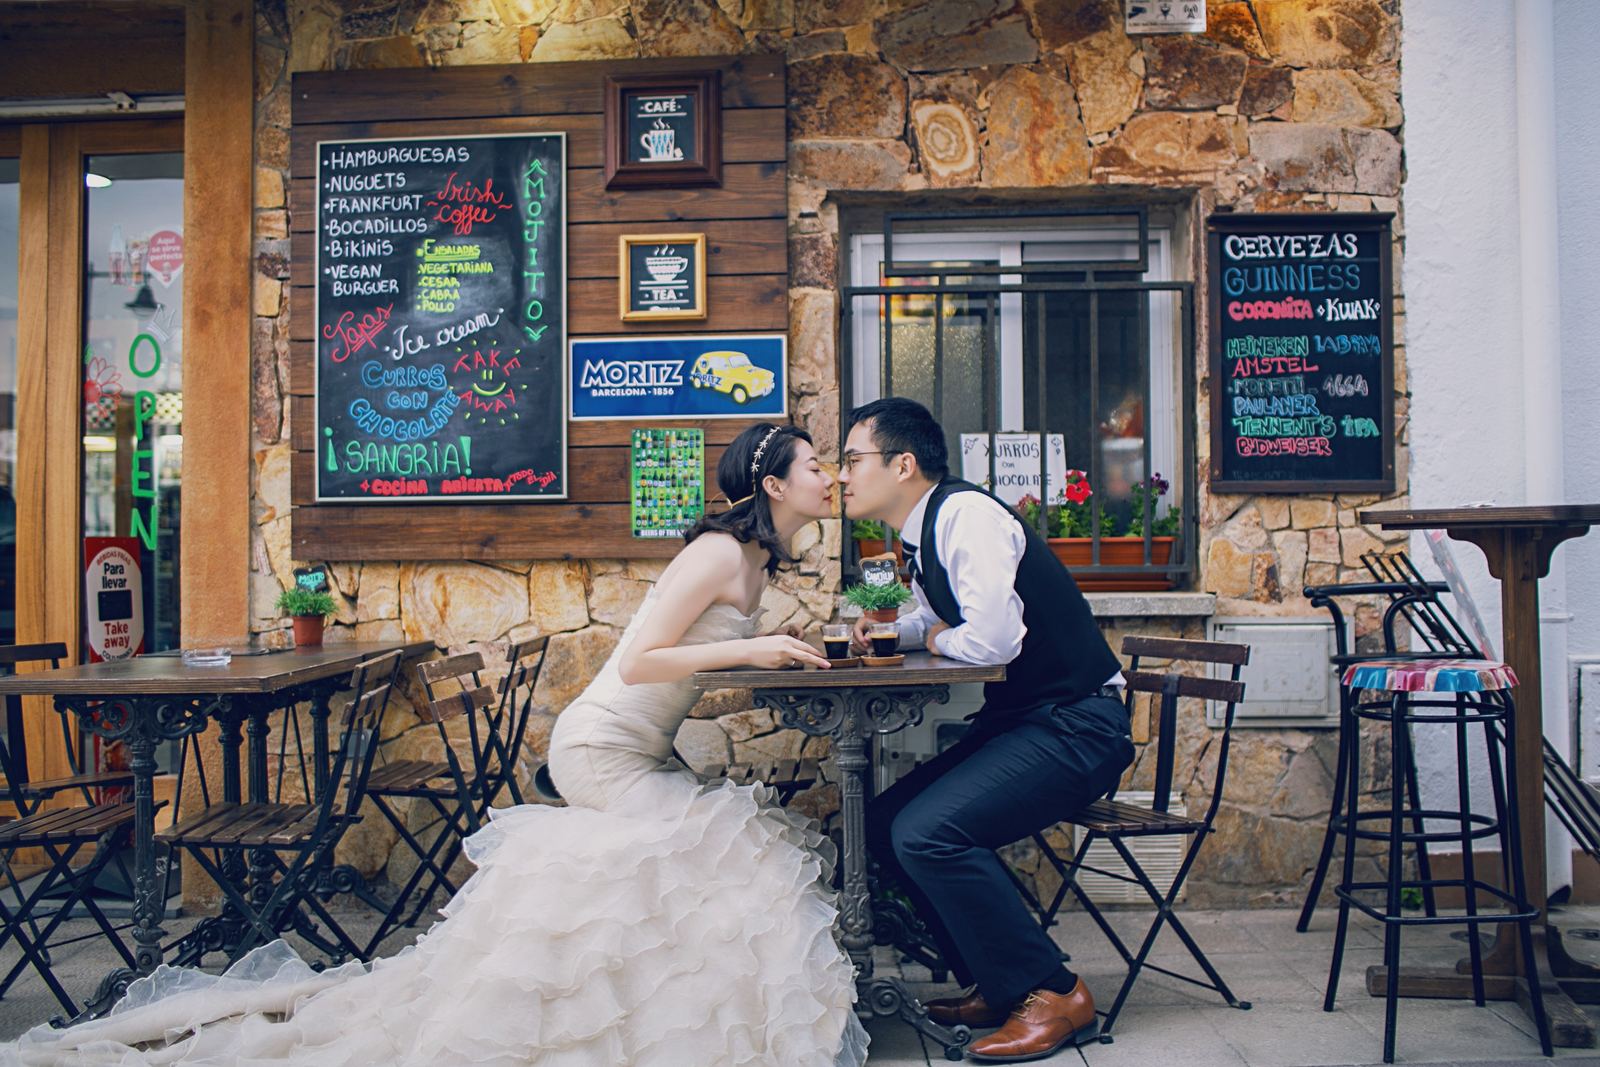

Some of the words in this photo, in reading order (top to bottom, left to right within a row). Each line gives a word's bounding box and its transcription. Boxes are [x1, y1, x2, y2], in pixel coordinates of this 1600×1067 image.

[644, 98, 677, 113] CAFÉ
[331, 146, 470, 170] HAMBURGUESAS
[330, 172, 407, 193] NUGUETS
[437, 172, 504, 204] Irish
[329, 195, 424, 214] FRANKFURT
[434, 203, 496, 236] Coffee
[1224, 233, 1359, 261] CERVEZAS
[330, 264, 383, 279] VEGAN
[1224, 263, 1361, 297] GUINNESS
[333, 279, 400, 298] BURGUER
[652, 289, 678, 301] TEA
[421, 300, 455, 313] POLLO
[1227, 335, 1310, 358] HEINEKEN
[453, 349, 521, 377] TAKE
[580, 358, 685, 389] MORITZ
[1232, 357, 1319, 378] AMSTEL
[360, 359, 449, 391] CURROS
[386, 391, 429, 410] CON
[458, 388, 517, 414] AWAY
[592, 388, 647, 398] BARCELONA
[652, 387, 674, 397] 1856
[128, 333, 162, 552] OPEN
[104, 562, 125, 575] Para
[102, 575, 128, 589] llevar
[104, 621, 129, 636] Take
[104, 635, 131, 650] away
